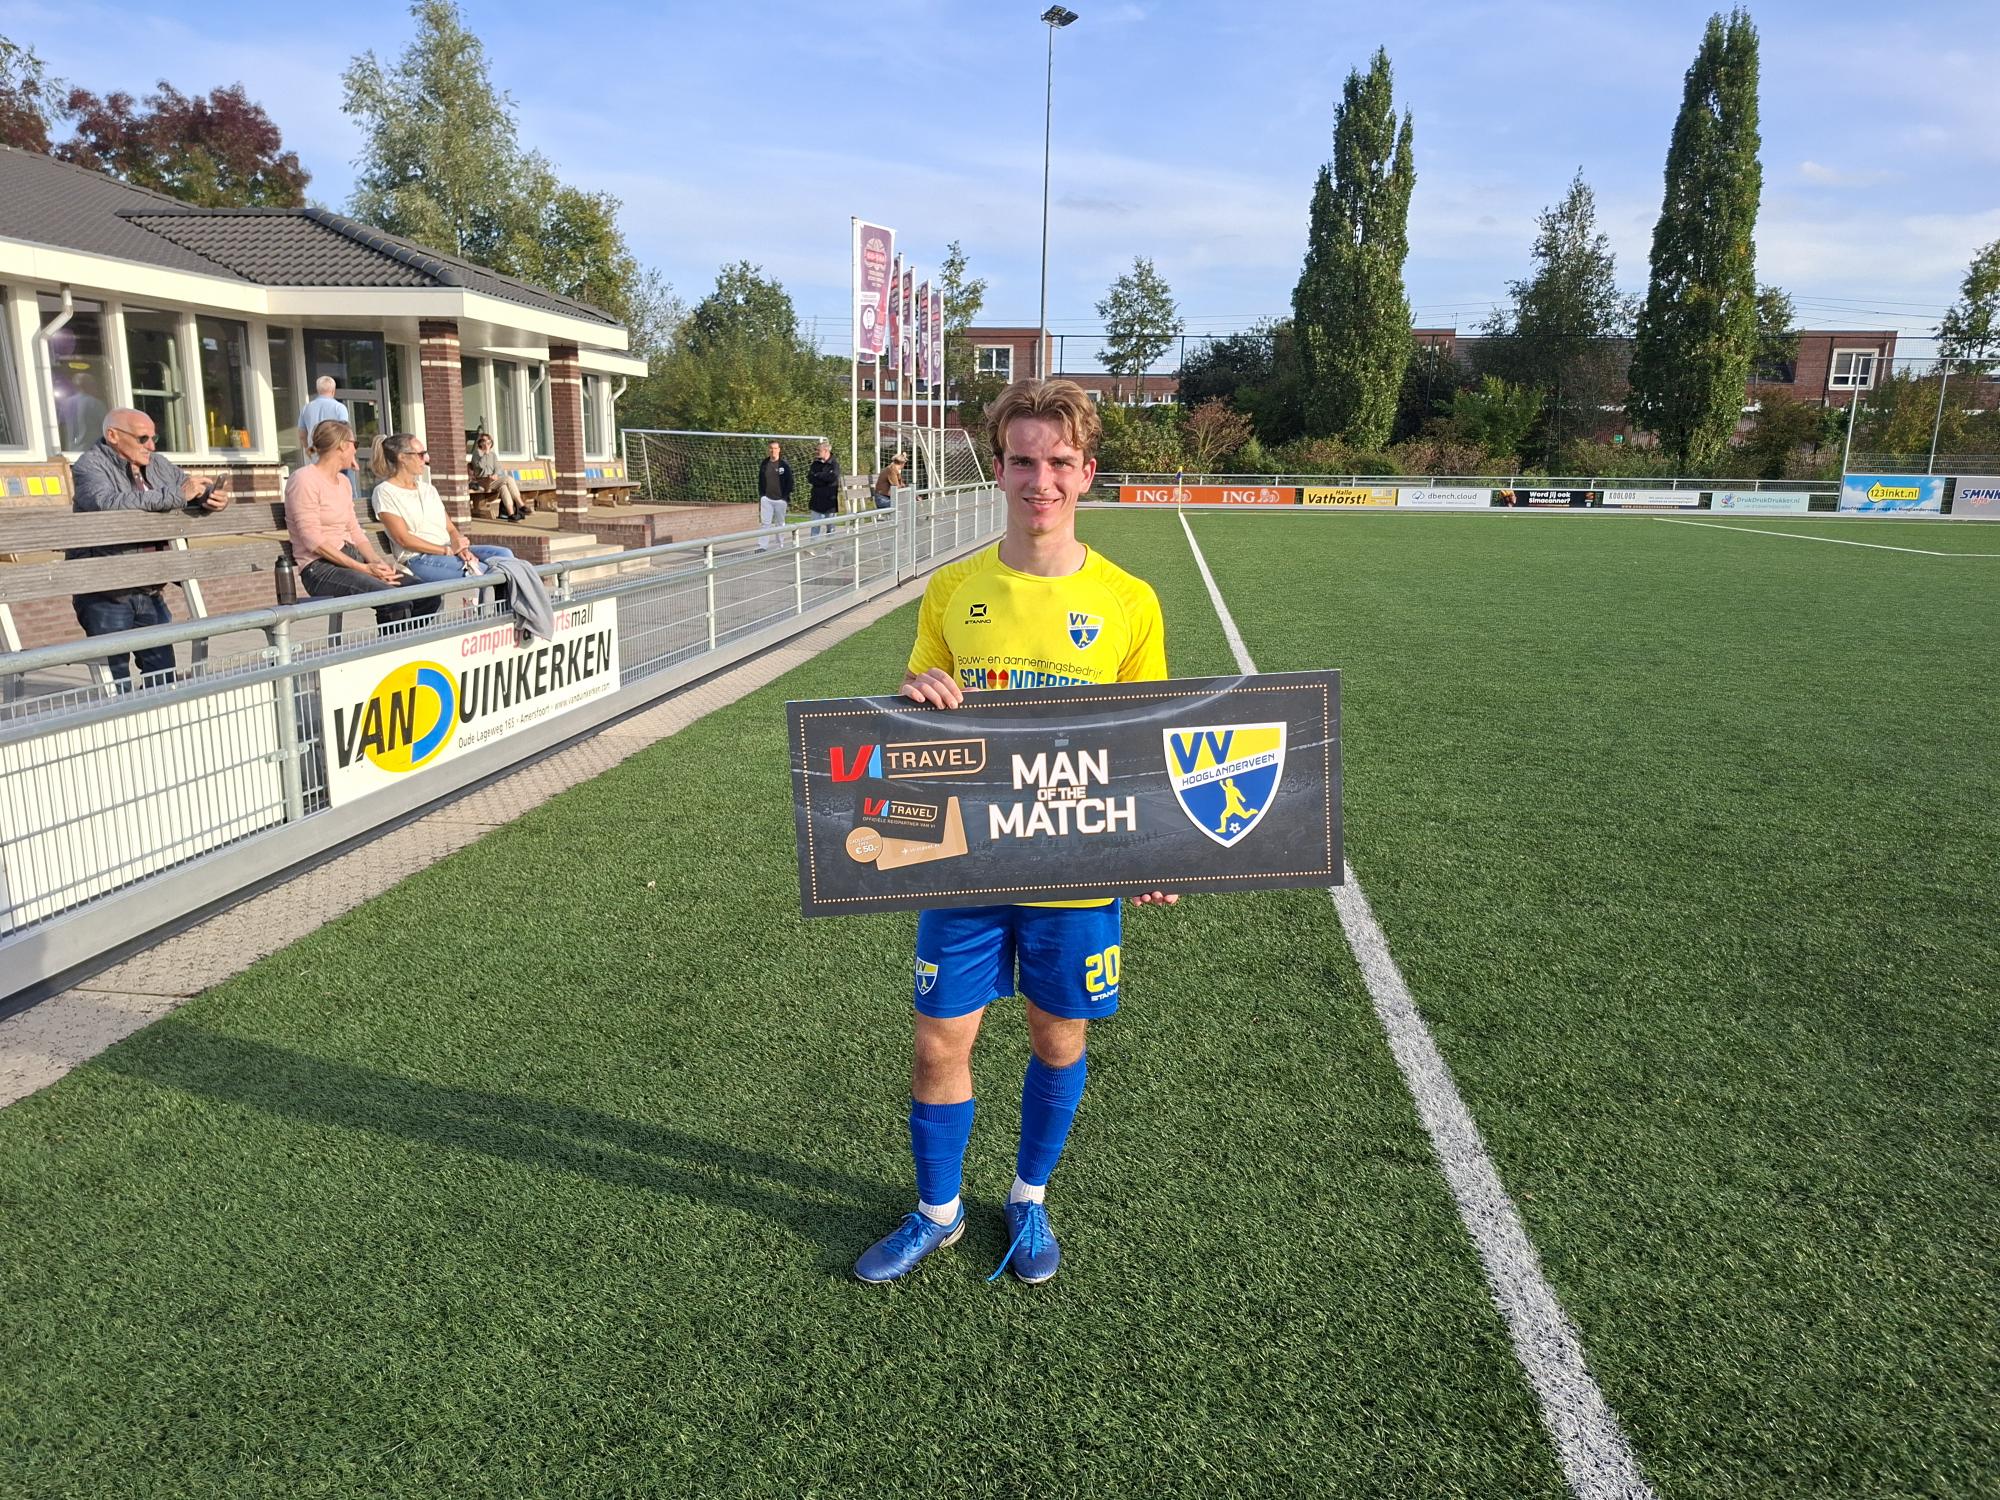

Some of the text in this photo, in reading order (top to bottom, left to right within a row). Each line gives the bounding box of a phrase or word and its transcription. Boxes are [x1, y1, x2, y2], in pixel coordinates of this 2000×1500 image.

[1136, 490, 1168, 502] ING
[1222, 491, 1255, 503] ING
[1308, 493, 1367, 505] Vathorst!
[1427, 491, 1477, 500] dbench.cloud
[1549, 491, 1557, 499] jij
[1870, 489, 1917, 499] 123inkt.nl
[461, 626, 521, 657] camping
[957, 655, 1103, 680] Bouw- en aannemingsbedrijf
[334, 686, 416, 769] VAN
[458, 735, 475, 748] Oude
[476, 724, 503, 742] Lageweg
[505, 718, 515, 731] 165
[520, 705, 550, 724] Amersfoort
[886, 748, 977, 769] TRAVEL
[1170, 730, 1234, 774] VV
[1011, 749, 1109, 790] MAN
[1182, 752, 1275, 787] HOOGLANDERVEEN
[1037, 786, 1087, 802] OF THE
[890, 804, 933, 818] TRAVEL
[988, 796, 1136, 840] MATCH
[1086, 945, 1120, 993] 20
